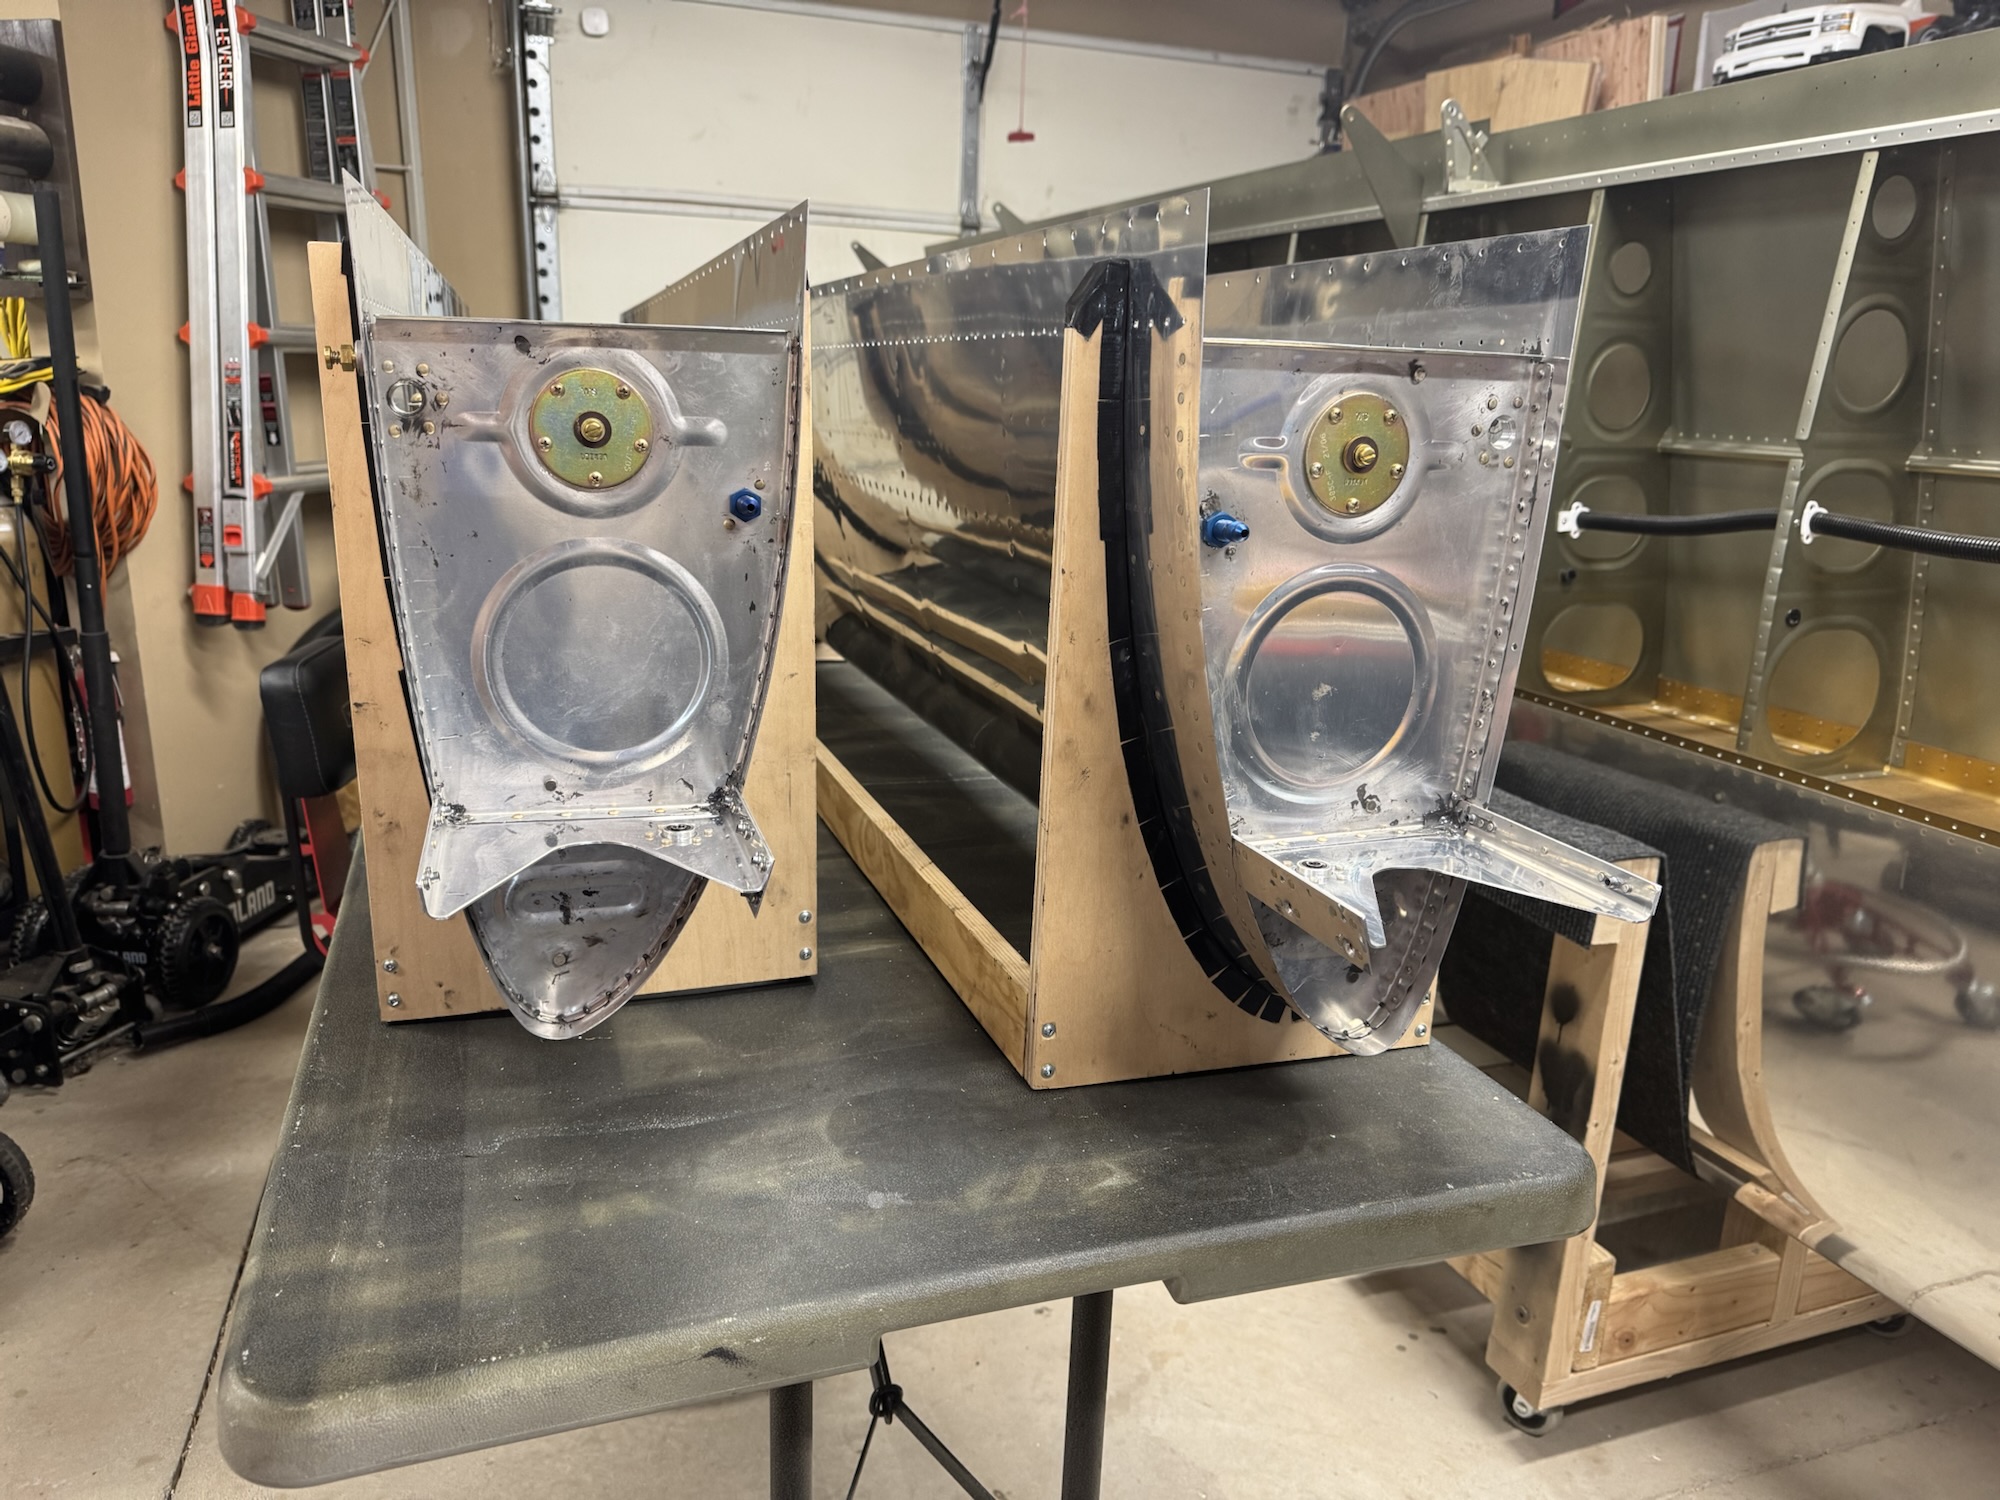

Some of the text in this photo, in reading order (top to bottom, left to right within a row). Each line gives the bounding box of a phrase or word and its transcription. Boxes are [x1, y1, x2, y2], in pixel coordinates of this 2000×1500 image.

[181, 4, 201, 107] Little Giant
[215, 28, 233, 90] LEVELER
